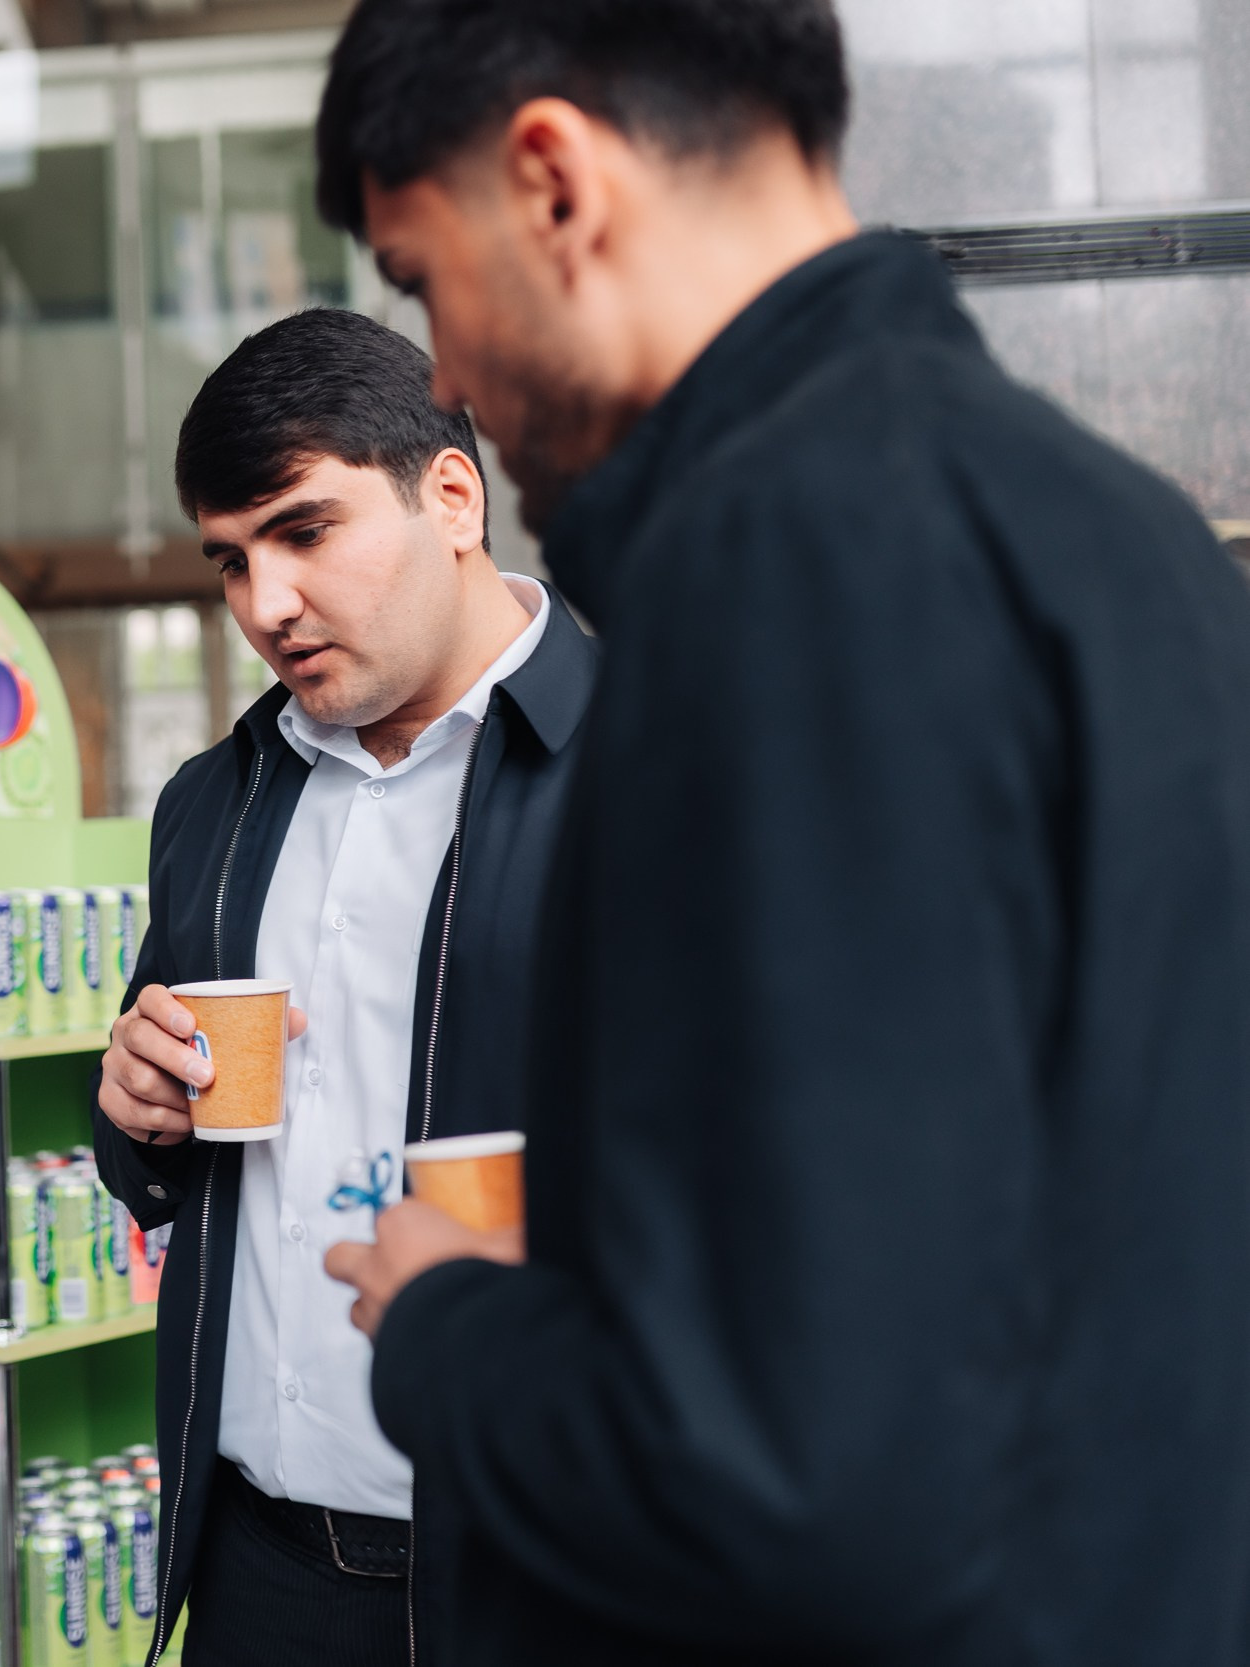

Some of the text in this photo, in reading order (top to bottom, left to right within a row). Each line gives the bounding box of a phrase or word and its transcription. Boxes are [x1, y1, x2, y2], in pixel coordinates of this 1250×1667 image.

[65, 1556, 87, 1642] SUNRISE
[104, 1542, 122, 1625] SUNRISE
[133, 1529, 157, 1613] SUNRISE
